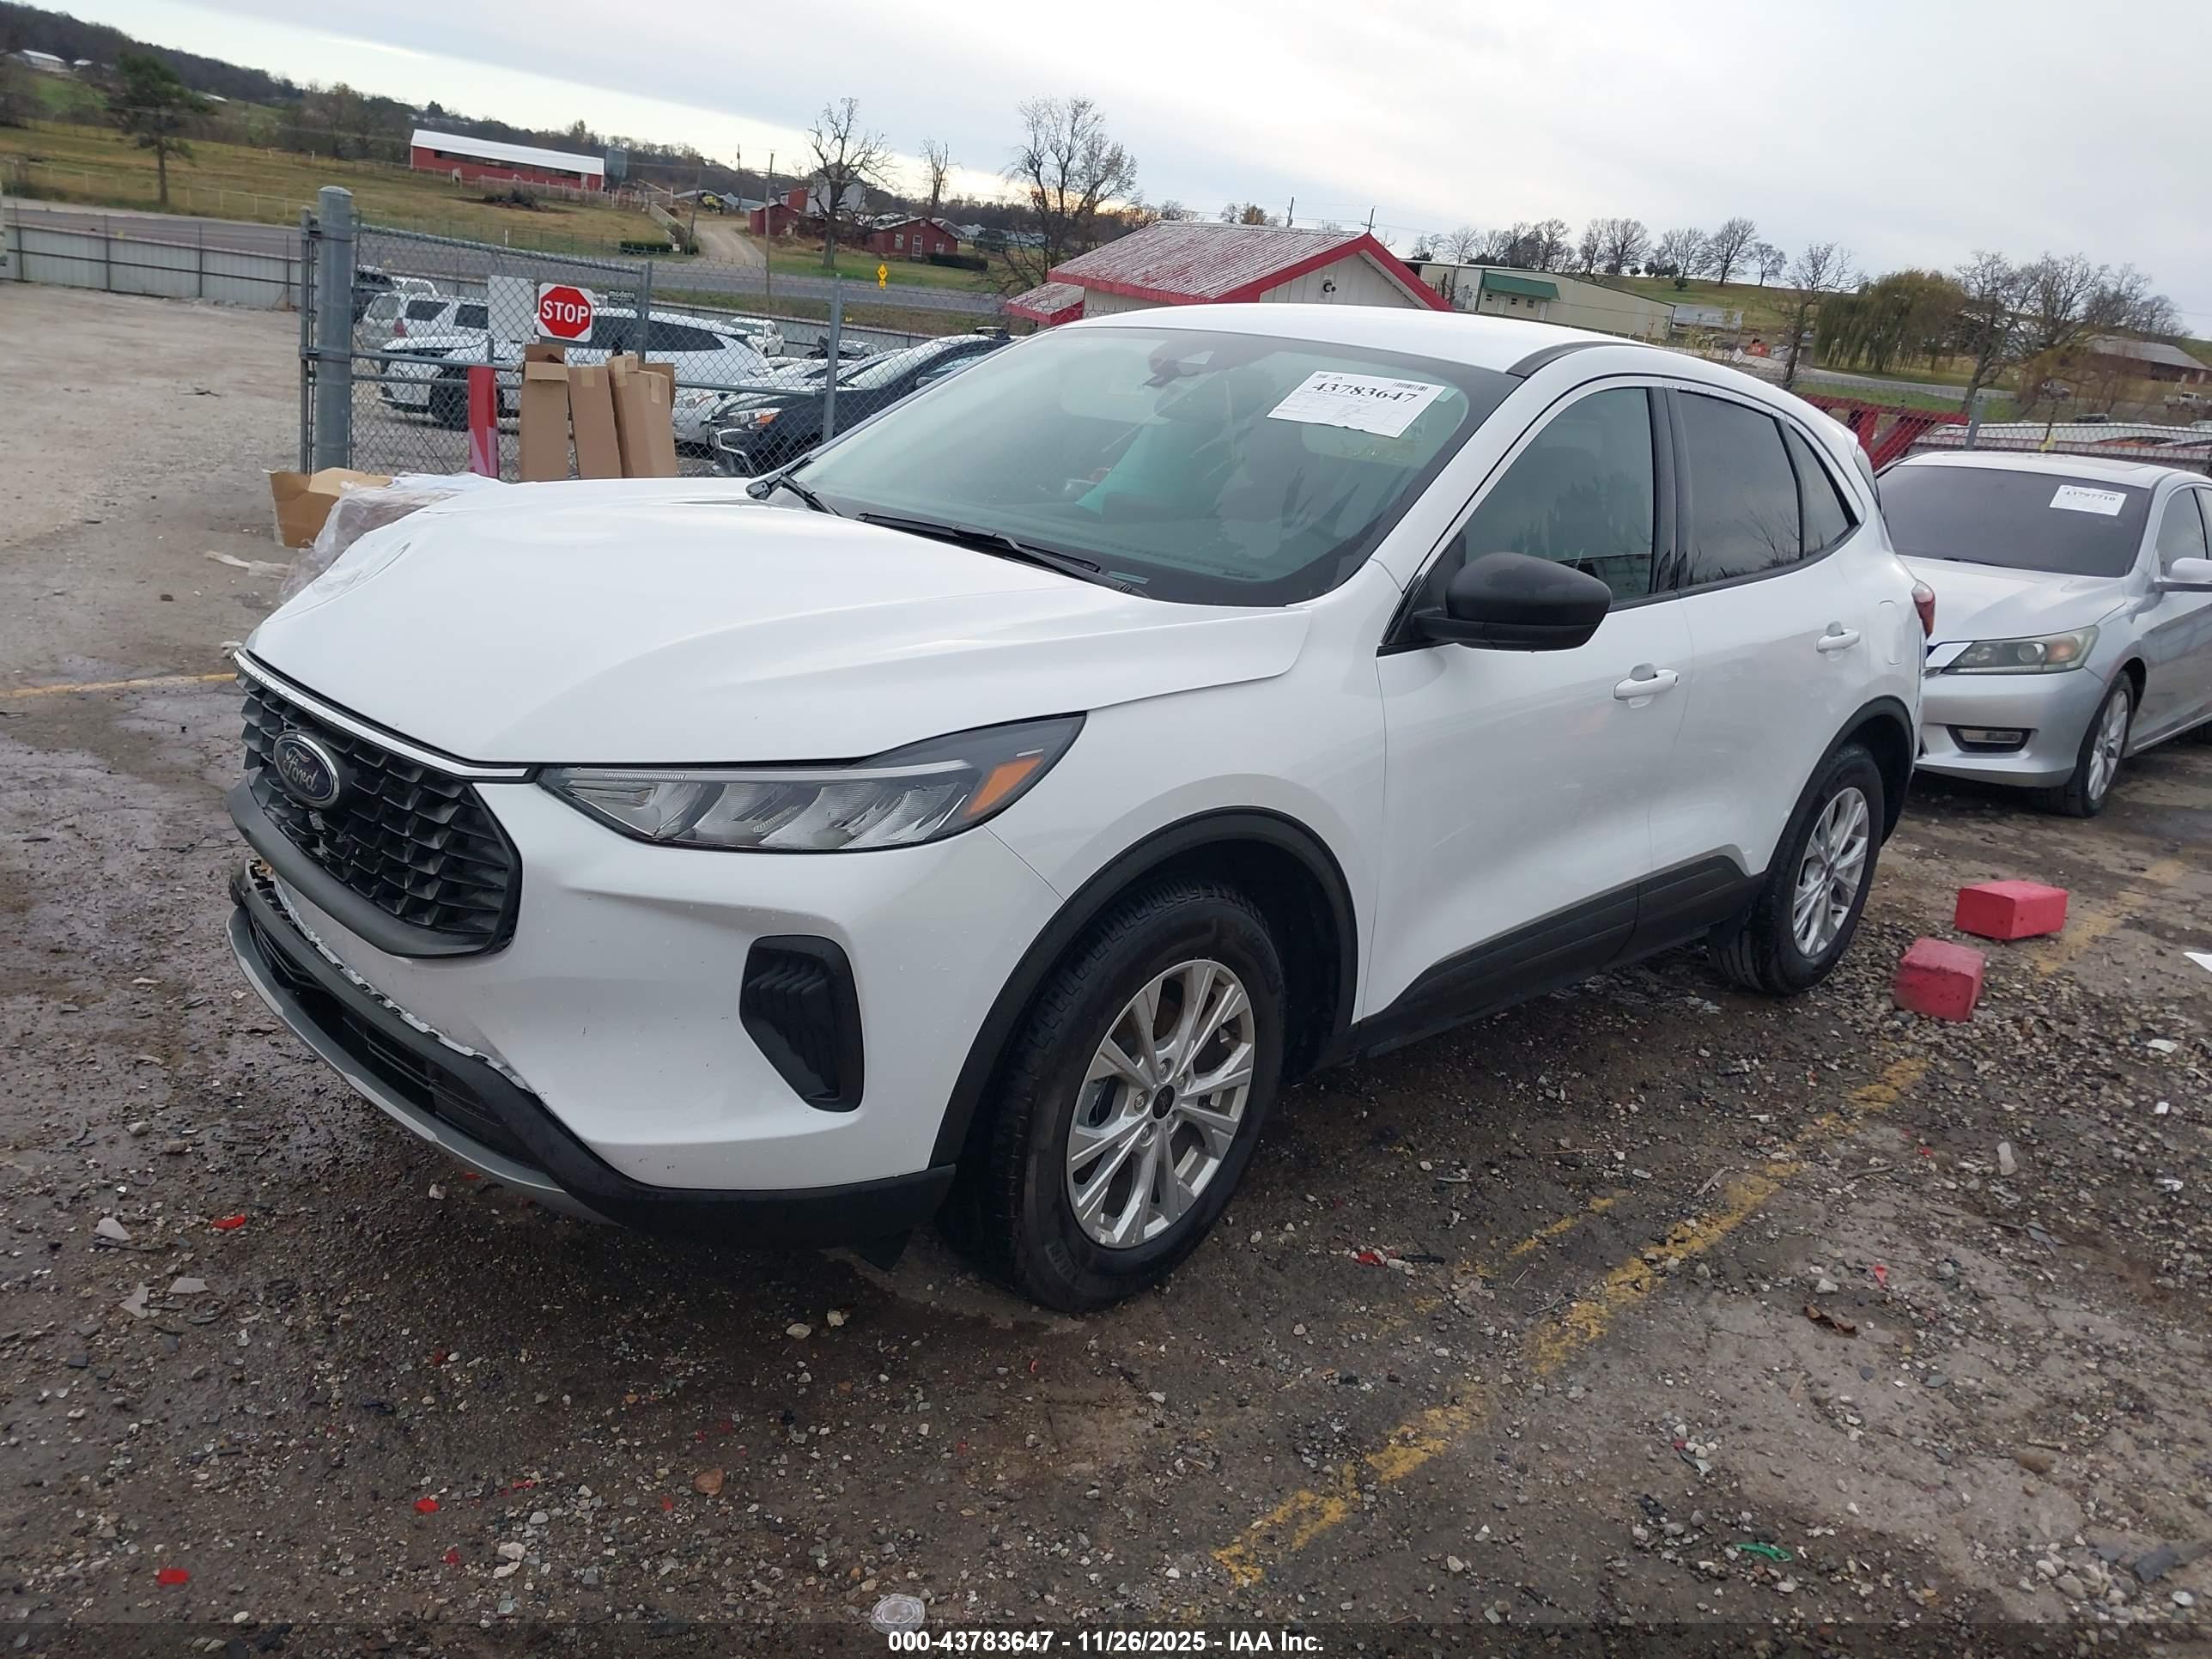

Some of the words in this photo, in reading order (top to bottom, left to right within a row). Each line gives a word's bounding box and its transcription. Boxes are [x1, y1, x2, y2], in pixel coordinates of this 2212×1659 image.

[542, 301, 589, 325] STOP
[1312, 382, 1419, 404] 43783647
[283, 746, 319, 792] Ford
